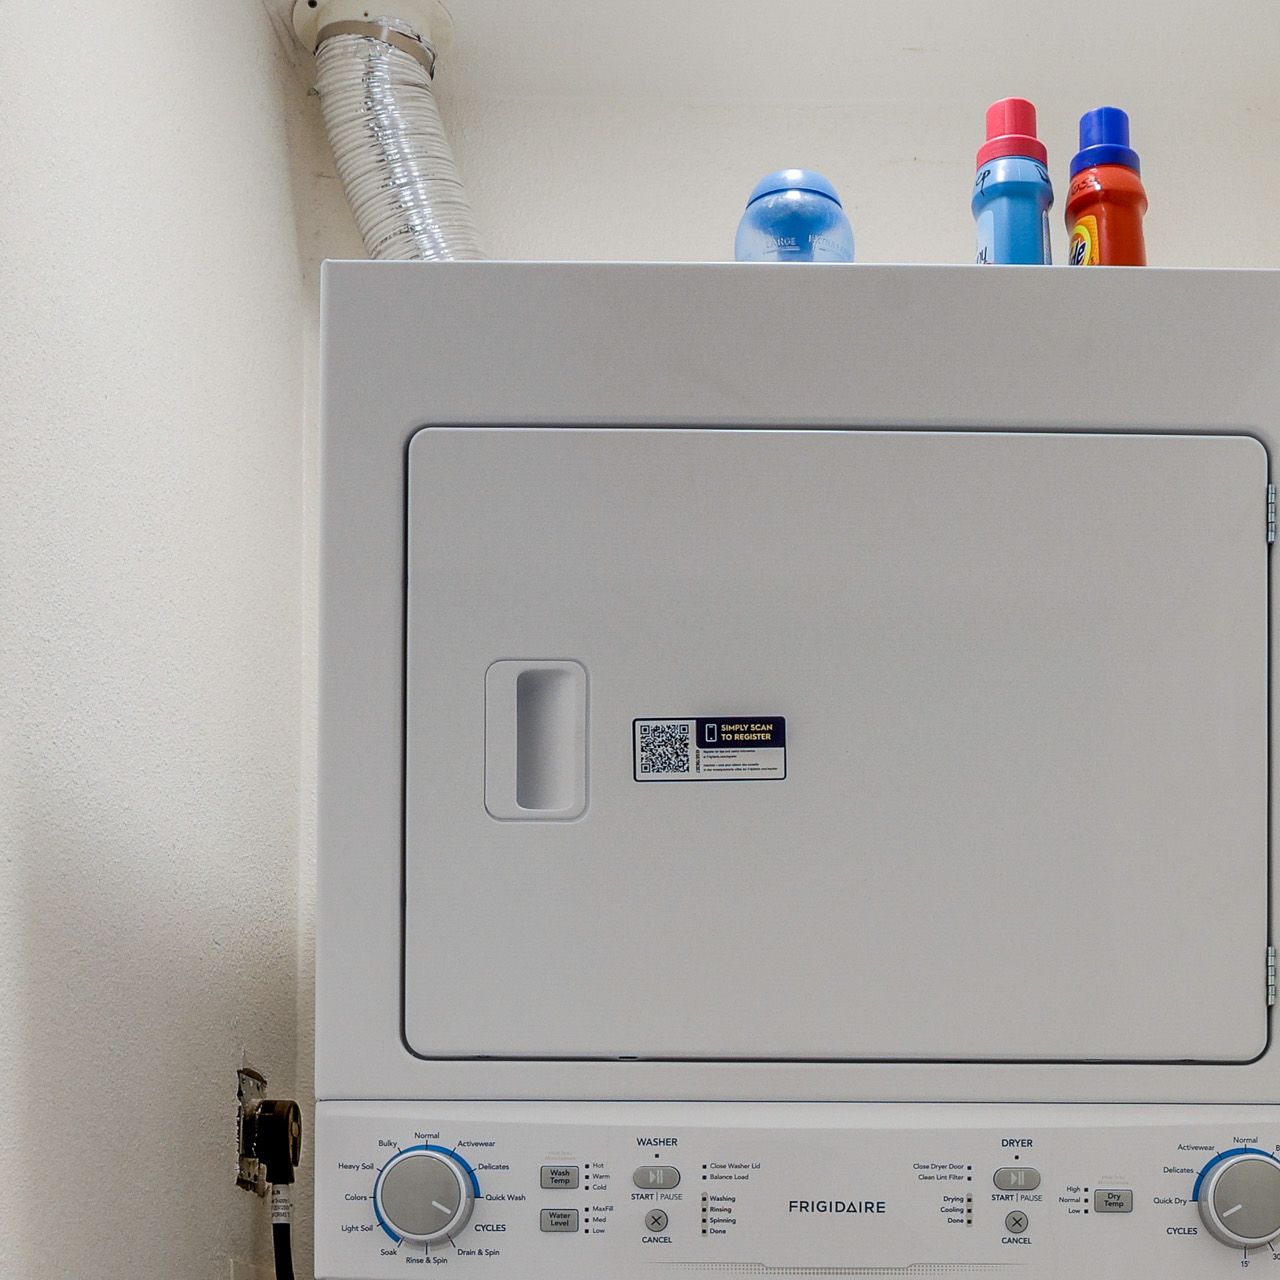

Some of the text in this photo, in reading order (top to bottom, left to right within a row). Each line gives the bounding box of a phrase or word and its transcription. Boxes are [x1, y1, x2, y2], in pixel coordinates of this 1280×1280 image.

[721, 723, 773, 732] SIMPLY SCAN
[721, 733, 771, 741] TO REGISTER
[378, 1140, 397, 1148] Bulky
[637, 1138, 678, 1146] WASHER
[1001, 1139, 1033, 1148] DRYER
[338, 1163, 360, 1171] Heavy
[550, 1177, 570, 1185] Temp
[485, 1194, 505, 1202] Quick
[1153, 1197, 1187, 1206] Quick Dry
[789, 1200, 886, 1213] FRIGIDAIRE
[1104, 1200, 1124, 1208] Temp
[341, 1225, 359, 1233] Light
[474, 1224, 506, 1232] CYCLES
[1166, 1227, 1198, 1235] CYCLES
[380, 1248, 397, 1256] Soak
[484, 1249, 500, 1257] Spin
[432, 1257, 448, 1265] Spin
